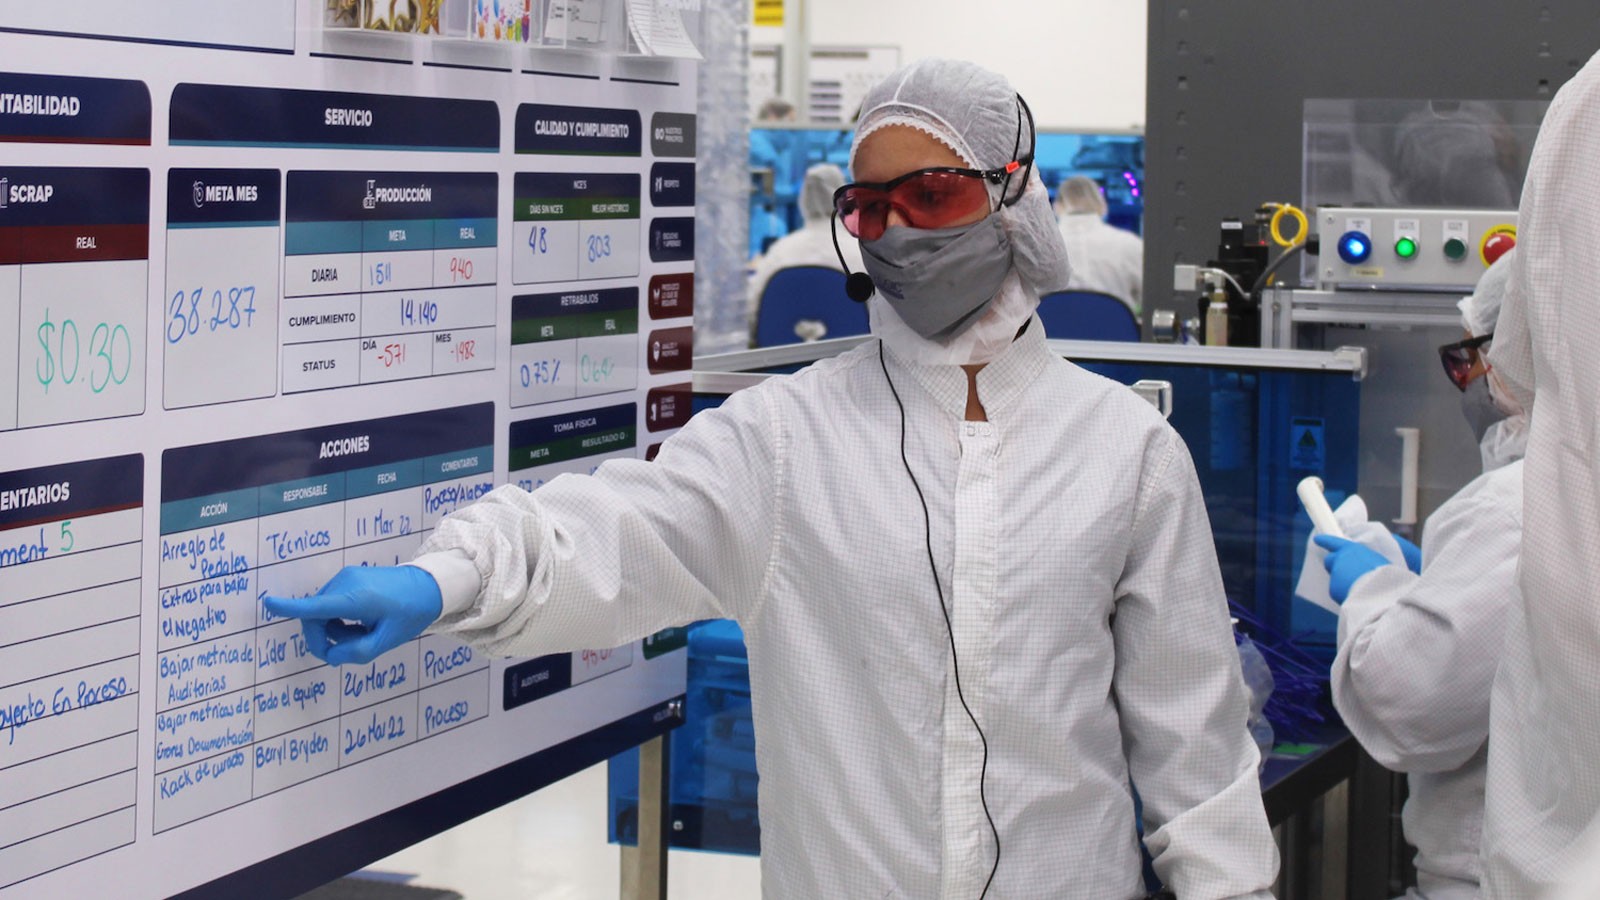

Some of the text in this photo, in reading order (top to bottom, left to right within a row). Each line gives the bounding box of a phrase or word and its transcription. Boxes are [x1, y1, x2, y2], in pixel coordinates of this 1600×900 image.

[325, 108, 372, 127] SERVICIO
[534, 120, 629, 139] CALIDAD Y CUMPLIMIENTO
[10, 185, 53, 203] SCRAP
[206, 185, 258, 203] META MES
[375, 184, 432, 203] PRODUCCIÓN
[76, 237, 97, 249] REAL
[388, 230, 406, 242] META
[459, 227, 476, 240] REAL
[528, 226, 547, 255] 48
[311, 268, 338, 282] DIARIA
[369, 262, 392, 286] 1511
[449, 257, 473, 283] 940
[560, 293, 599, 306] RETRABAJOS
[167, 285, 256, 344] 38.287
[288, 313, 356, 327] CUMPLIMIENTO
[435, 333, 451, 343] MES
[541, 325, 554, 337] META
[36, 307, 131, 394] $0.30
[362, 338, 377, 350] DÍA
[302, 359, 336, 372] STATUS
[553, 421, 574, 433] TOMA
[319, 435, 370, 459] ACCIONES
[581, 432, 618, 448] RESULTADO
[441, 456, 479, 473] COMENTARIOS
[530, 447, 550, 459] META
[377, 471, 397, 485] FECHA
[0, 482, 70, 511] ENTARIOS
[283, 483, 328, 502] RESPONSABLE
[200, 501, 228, 518] ACCIÓN
[357, 508, 412, 537] 11 Mar 22
[60, 521, 74, 552] 5
[265, 530, 331, 560] Técnicos
[162, 528, 226, 570] Arreglo de
[201, 552, 249, 580] Pedales
[162, 576, 249, 609] Extras para bajar
[162, 620, 173, 637] el
[175, 605, 227, 641] Negativo
[160, 653, 195, 680] Bajar
[241, 643, 253, 662] de
[424, 645, 473, 679] Proceso
[344, 662, 406, 698] 26 Mar 22
[52, 687, 72, 716] En
[253, 681, 326, 713] Todo el equipo
[158, 714, 188, 735] Bajar
[236, 696, 250, 714] de
[425, 701, 469, 734] Proceso
[345, 713, 405, 755] 26 Mar 22
[290, 731, 329, 763] Bryden
[160, 769, 194, 800] Rack
[195, 762, 210, 782] de
